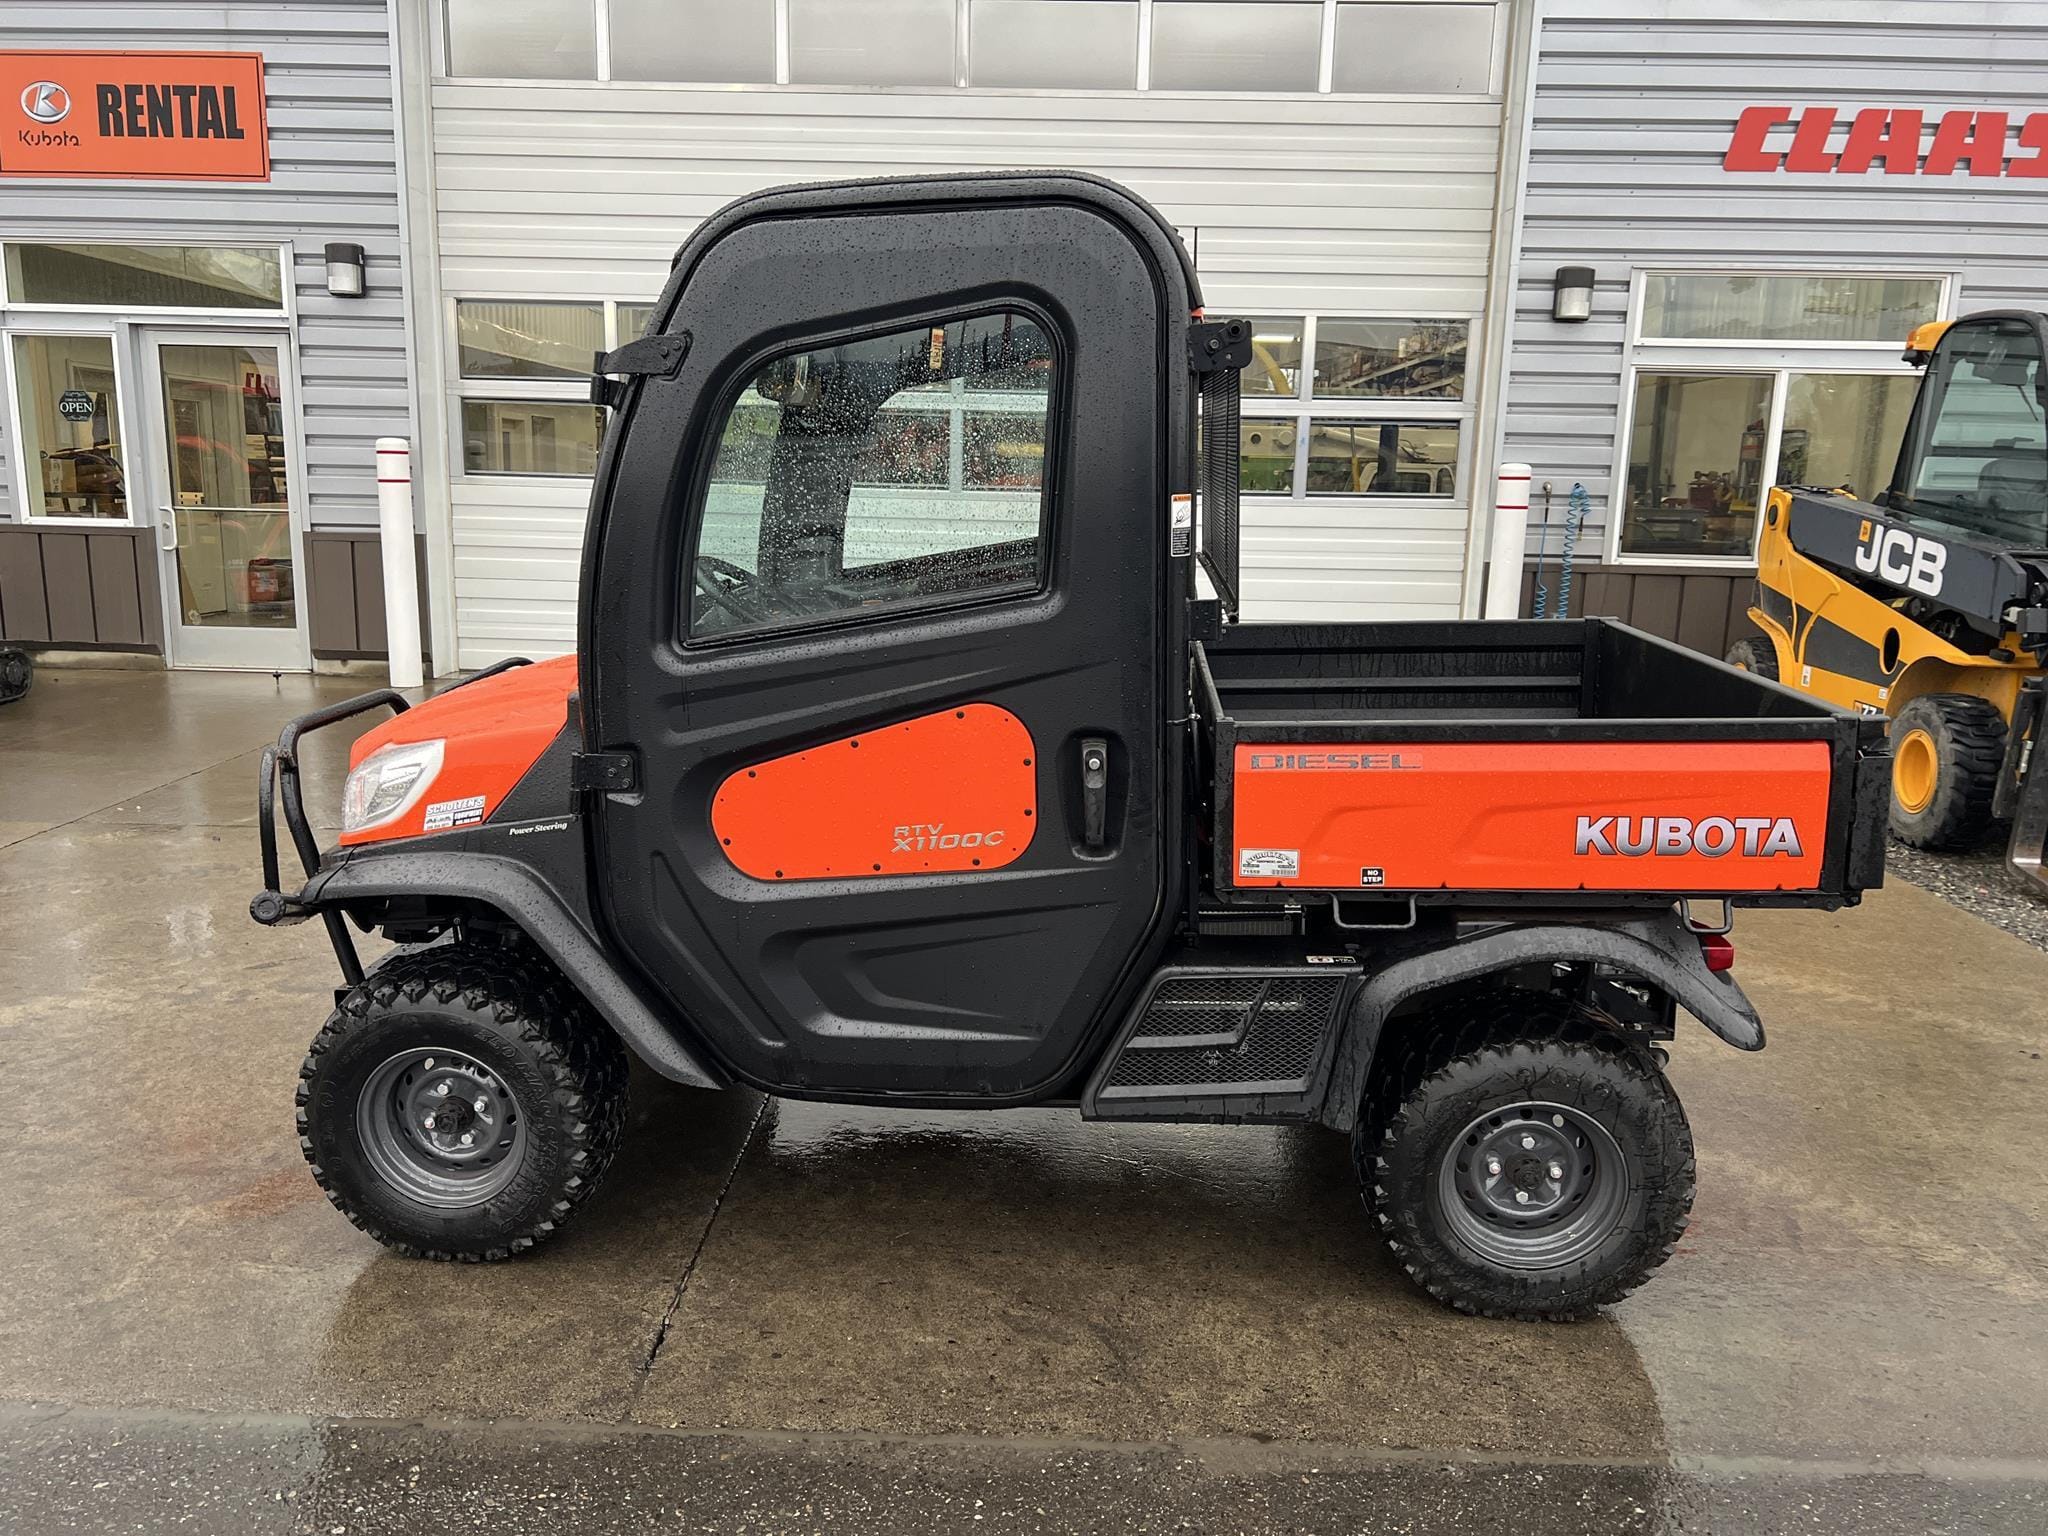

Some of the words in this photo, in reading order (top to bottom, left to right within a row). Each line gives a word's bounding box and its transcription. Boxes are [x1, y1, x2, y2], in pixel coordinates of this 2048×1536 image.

[96, 84, 245, 140] RENTAL
[18, 130, 81, 147] Kubota
[60, 402, 93, 413] OPEN
[1855, 524, 1947, 597] JCB
[1251, 754, 1422, 770] DIESEL
[509, 827, 534, 836] Power
[534, 821, 568, 833] Steering
[894, 823, 944, 838] RTV
[1574, 816, 1804, 857] KUBOTA
[890, 830, 1005, 854] X1100C
